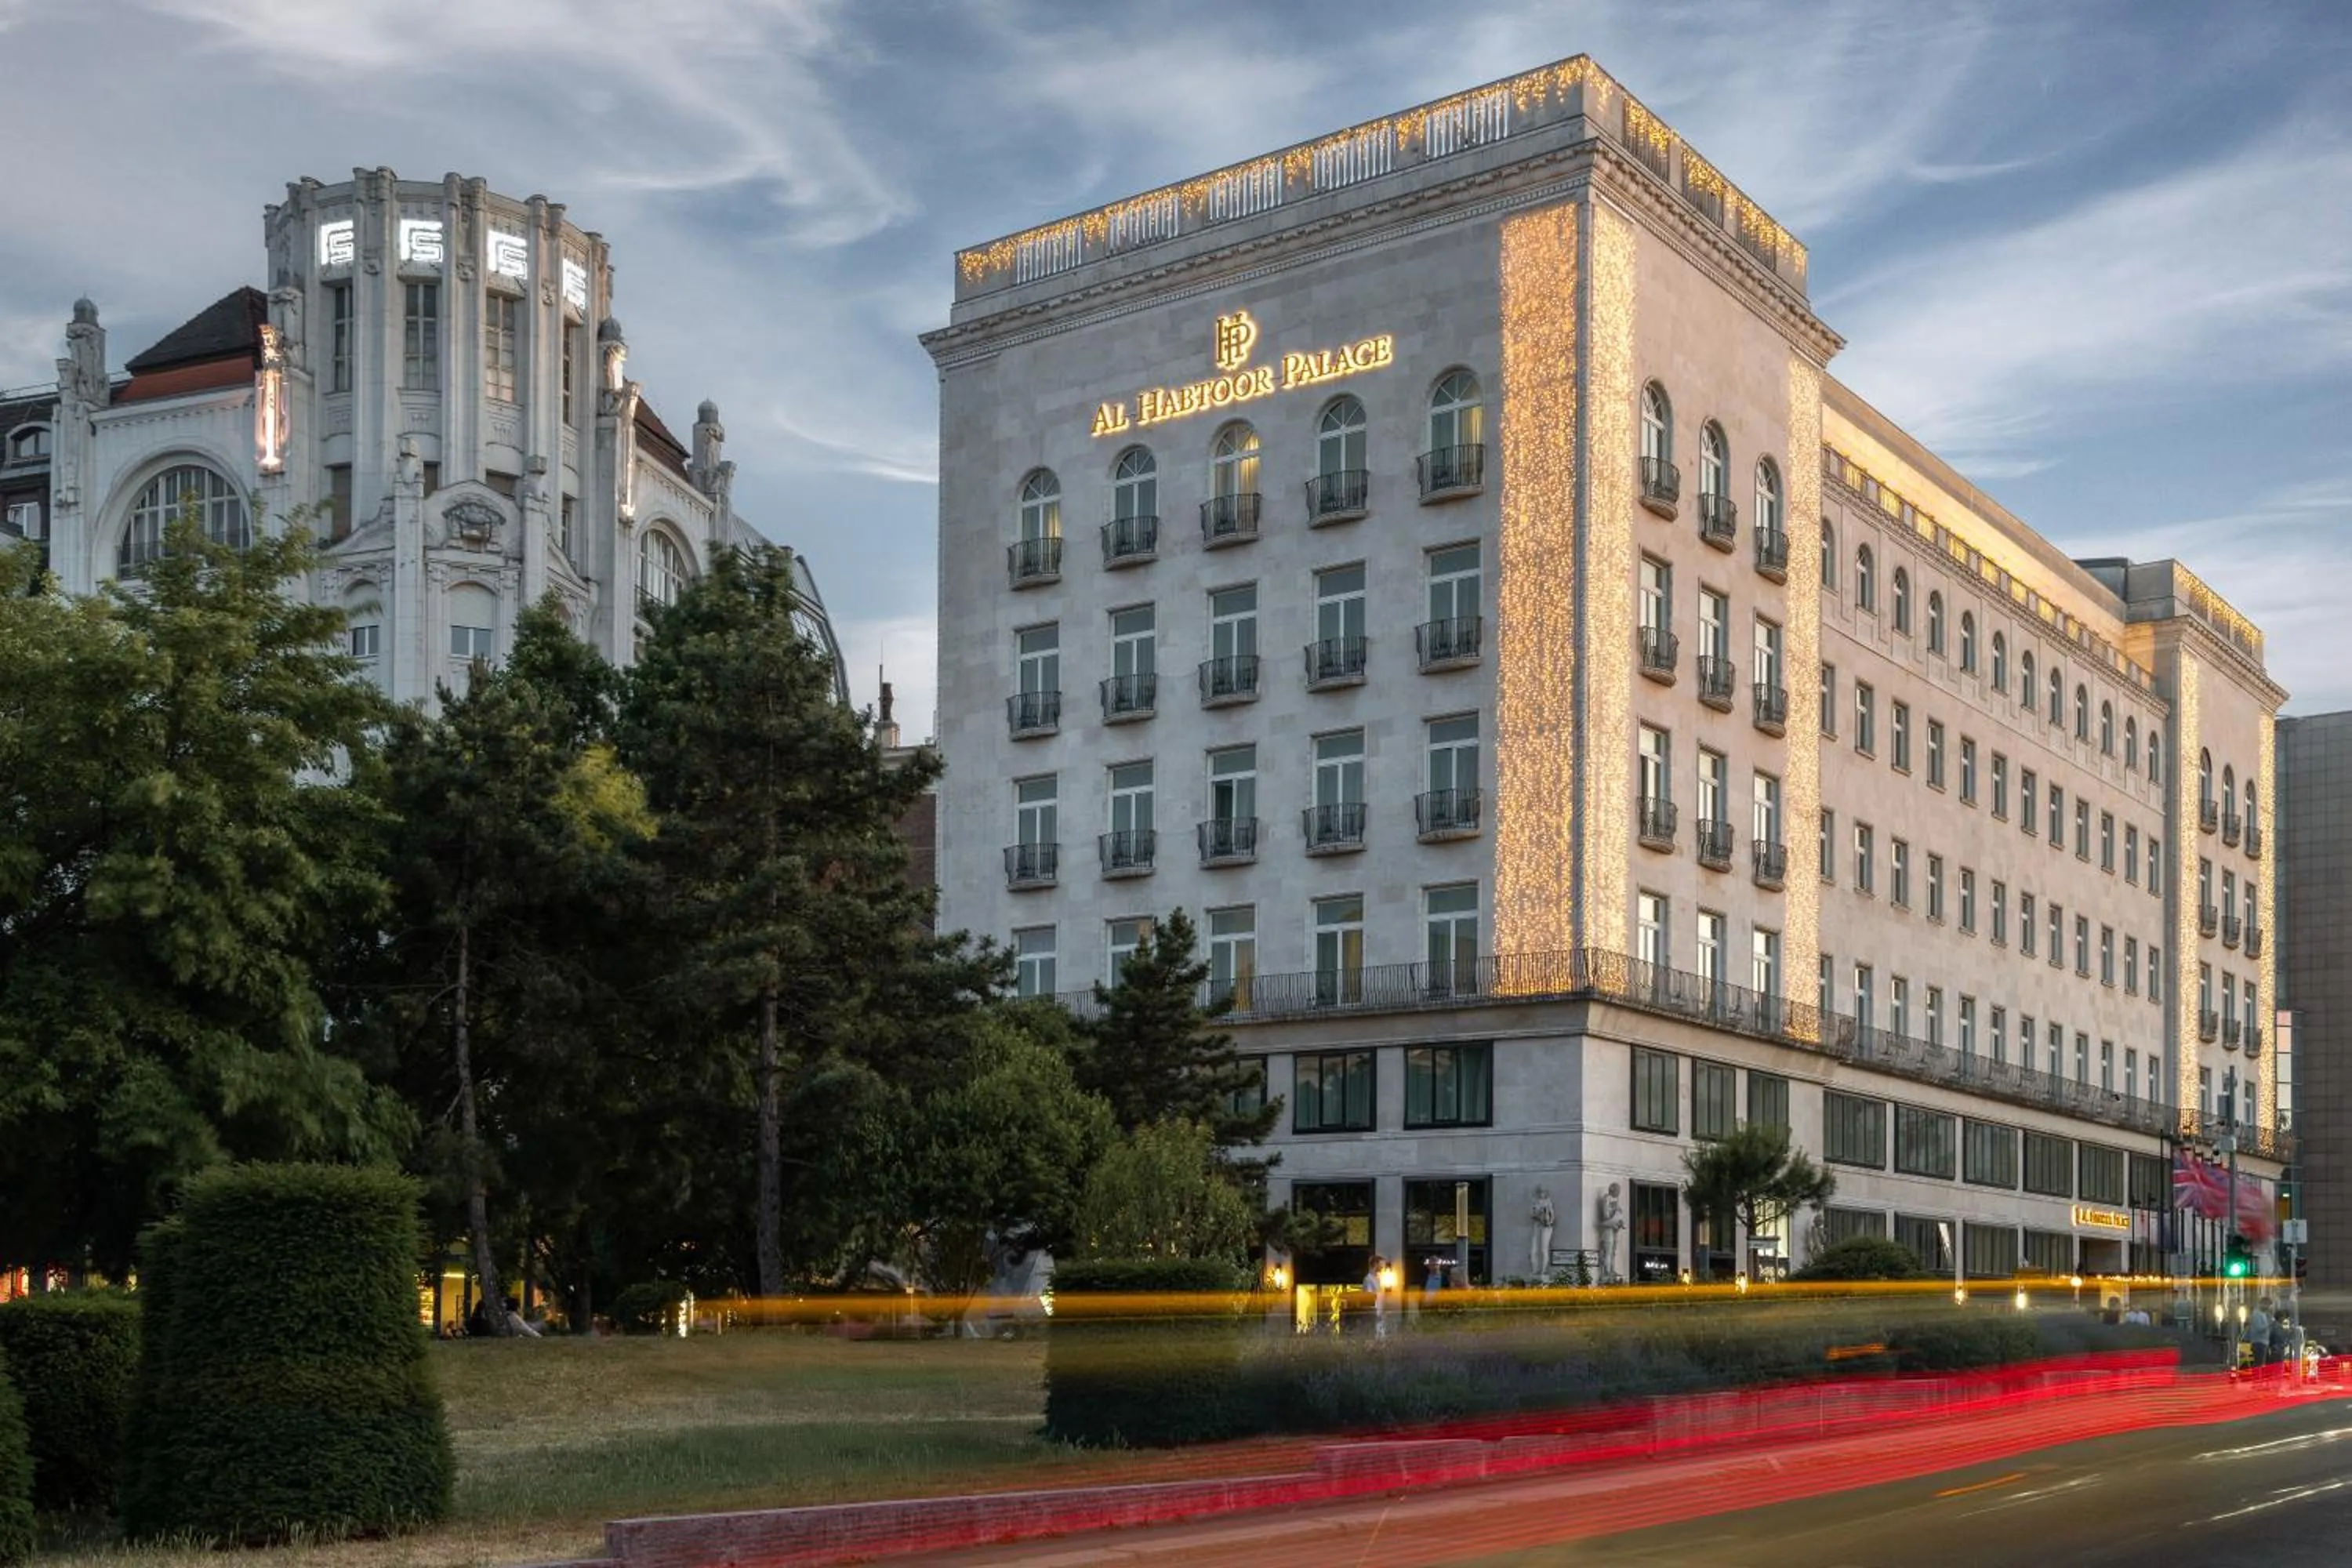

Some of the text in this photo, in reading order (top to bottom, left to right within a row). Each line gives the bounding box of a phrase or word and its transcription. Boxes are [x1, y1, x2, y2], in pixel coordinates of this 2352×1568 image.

[1091, 336, 1393, 436] AL HABTOOR PALACE
